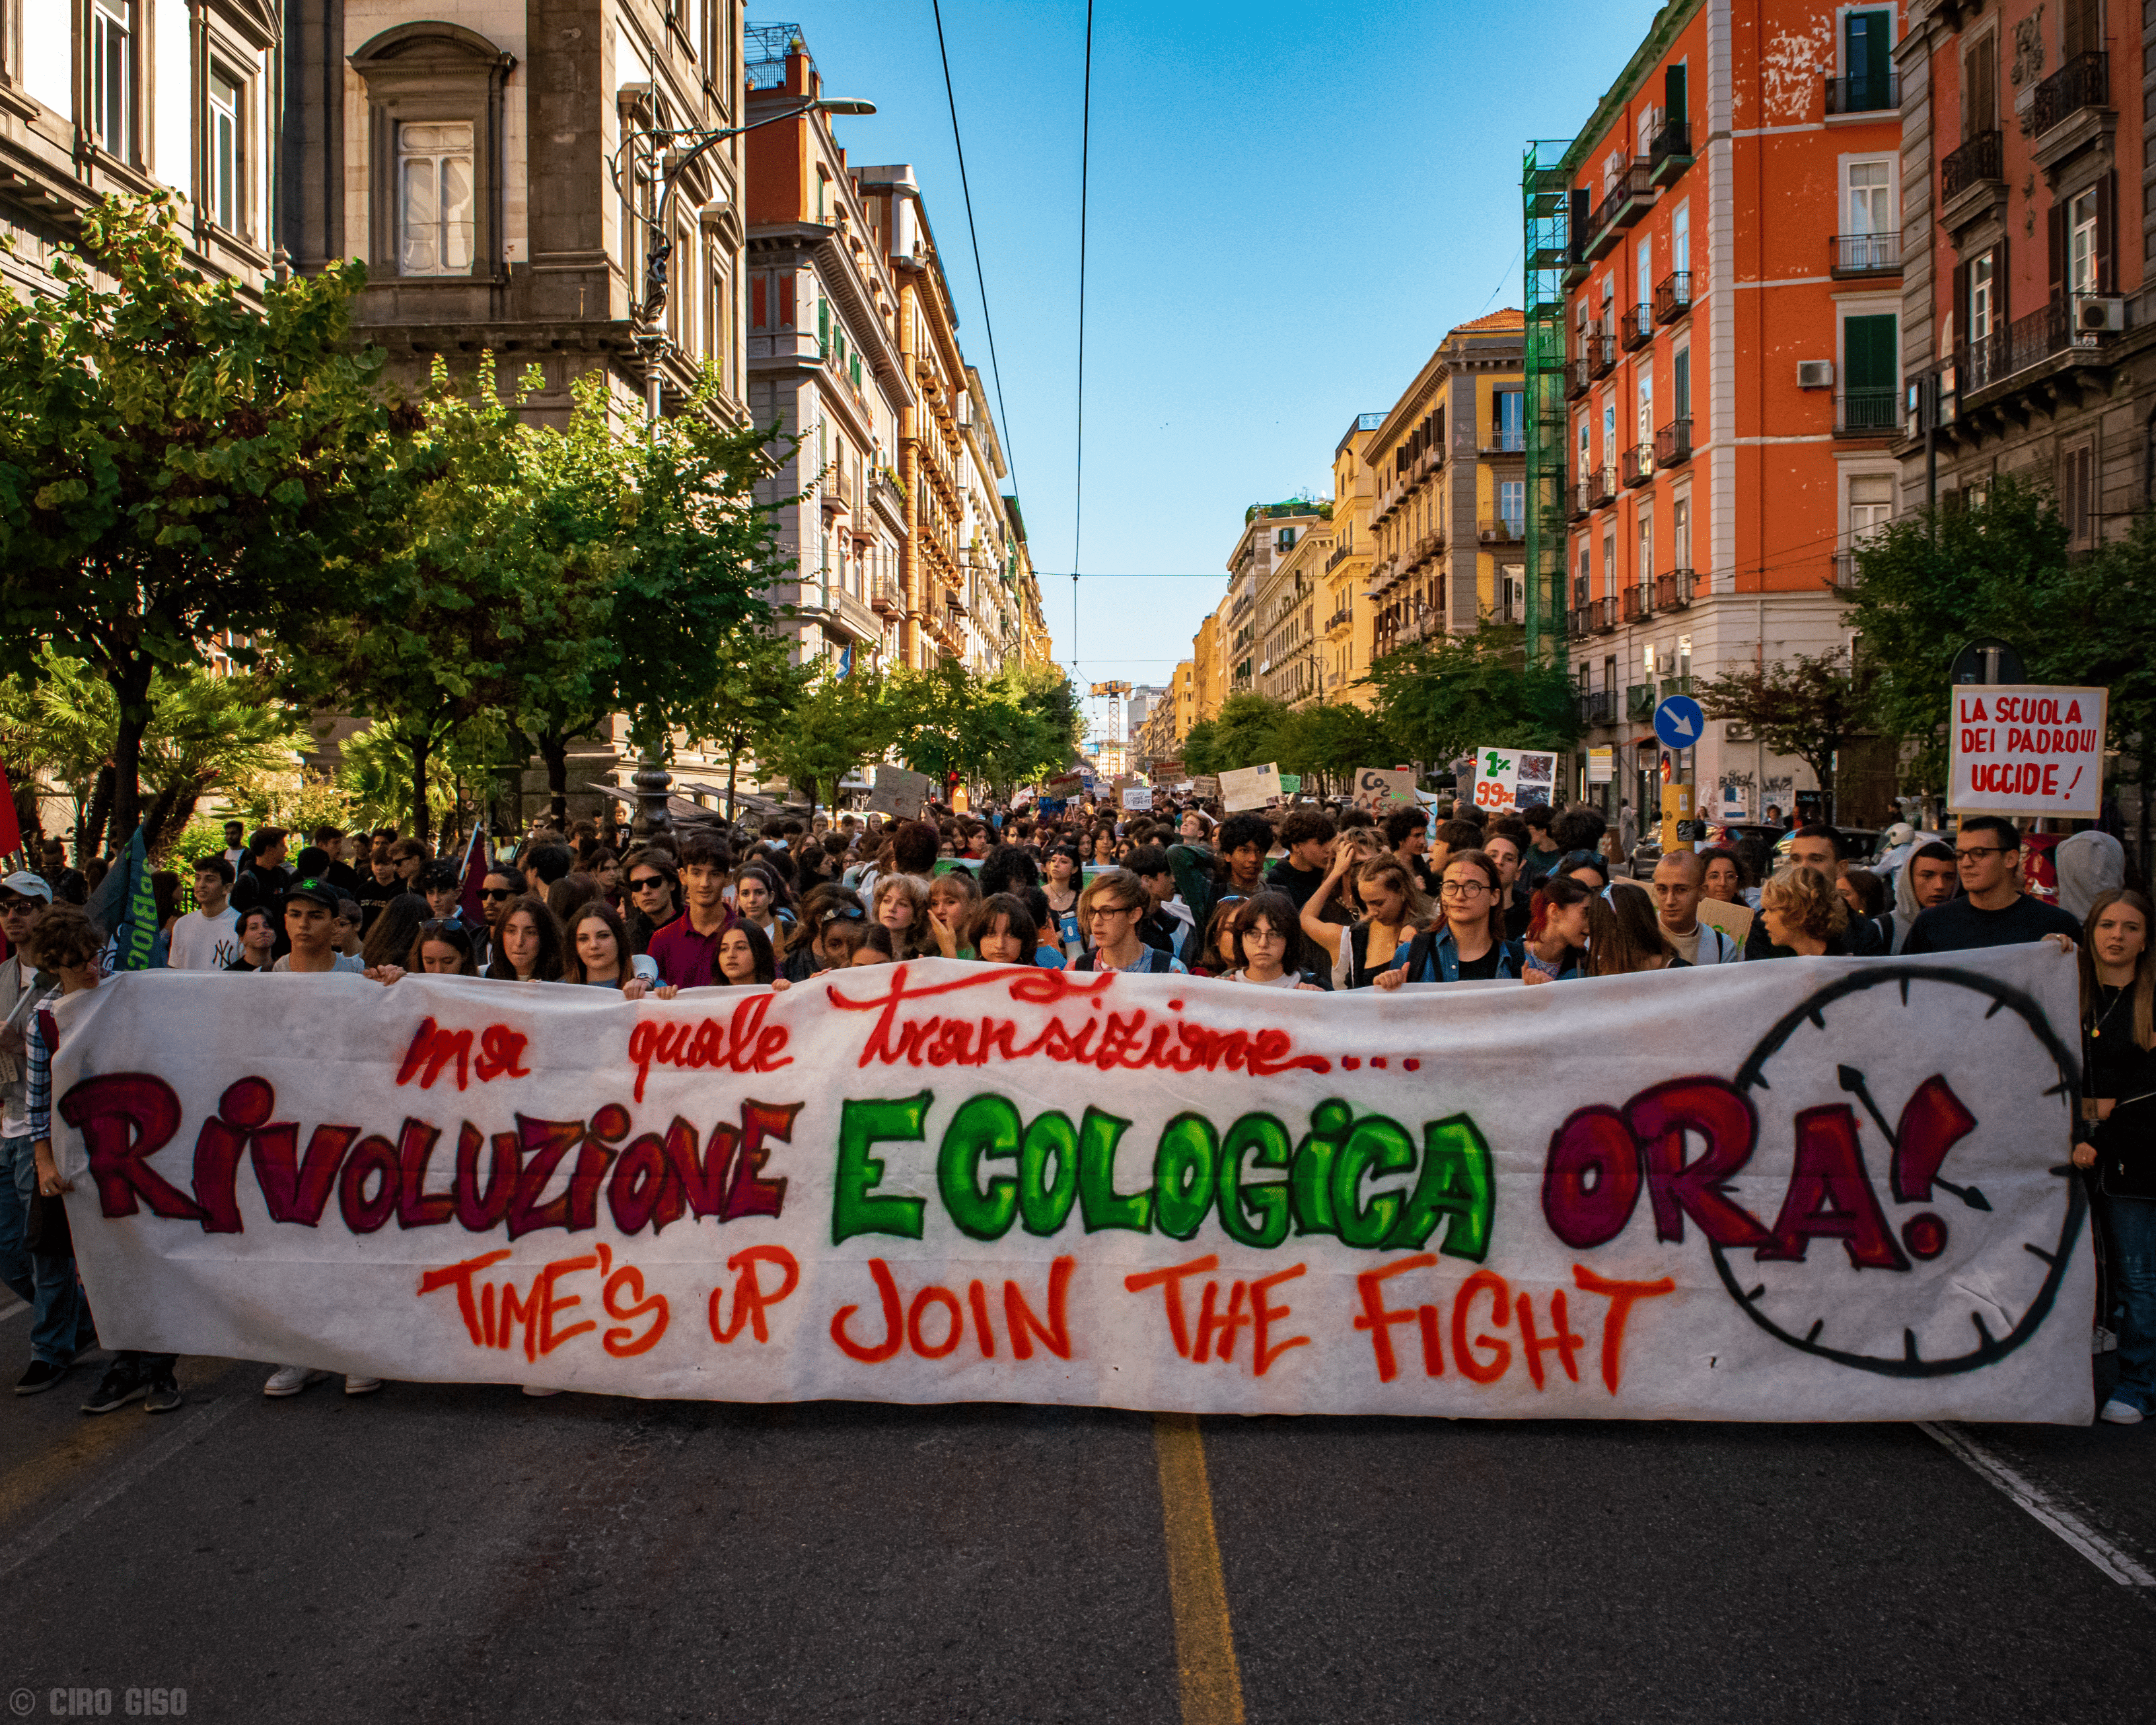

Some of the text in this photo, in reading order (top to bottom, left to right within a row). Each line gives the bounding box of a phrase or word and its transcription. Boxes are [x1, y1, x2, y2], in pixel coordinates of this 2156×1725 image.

[1960, 697, 2082, 725] LA SCUOLA
[1961, 728, 1995, 754] DEI
[1484, 751, 1511, 778] 1%
[1475, 781, 1515, 807] 99%
[396, 1016, 531, 1091] ma
[628, 993, 794, 1103] quale
[1541, 1073, 1978, 1272] ORA!
[417, 1242, 670, 1364] TIME'S
[708, 1245, 800, 1344] UP
[830, 1254, 1078, 1365] JOIN
[1124, 1253, 1311, 1377] THE
